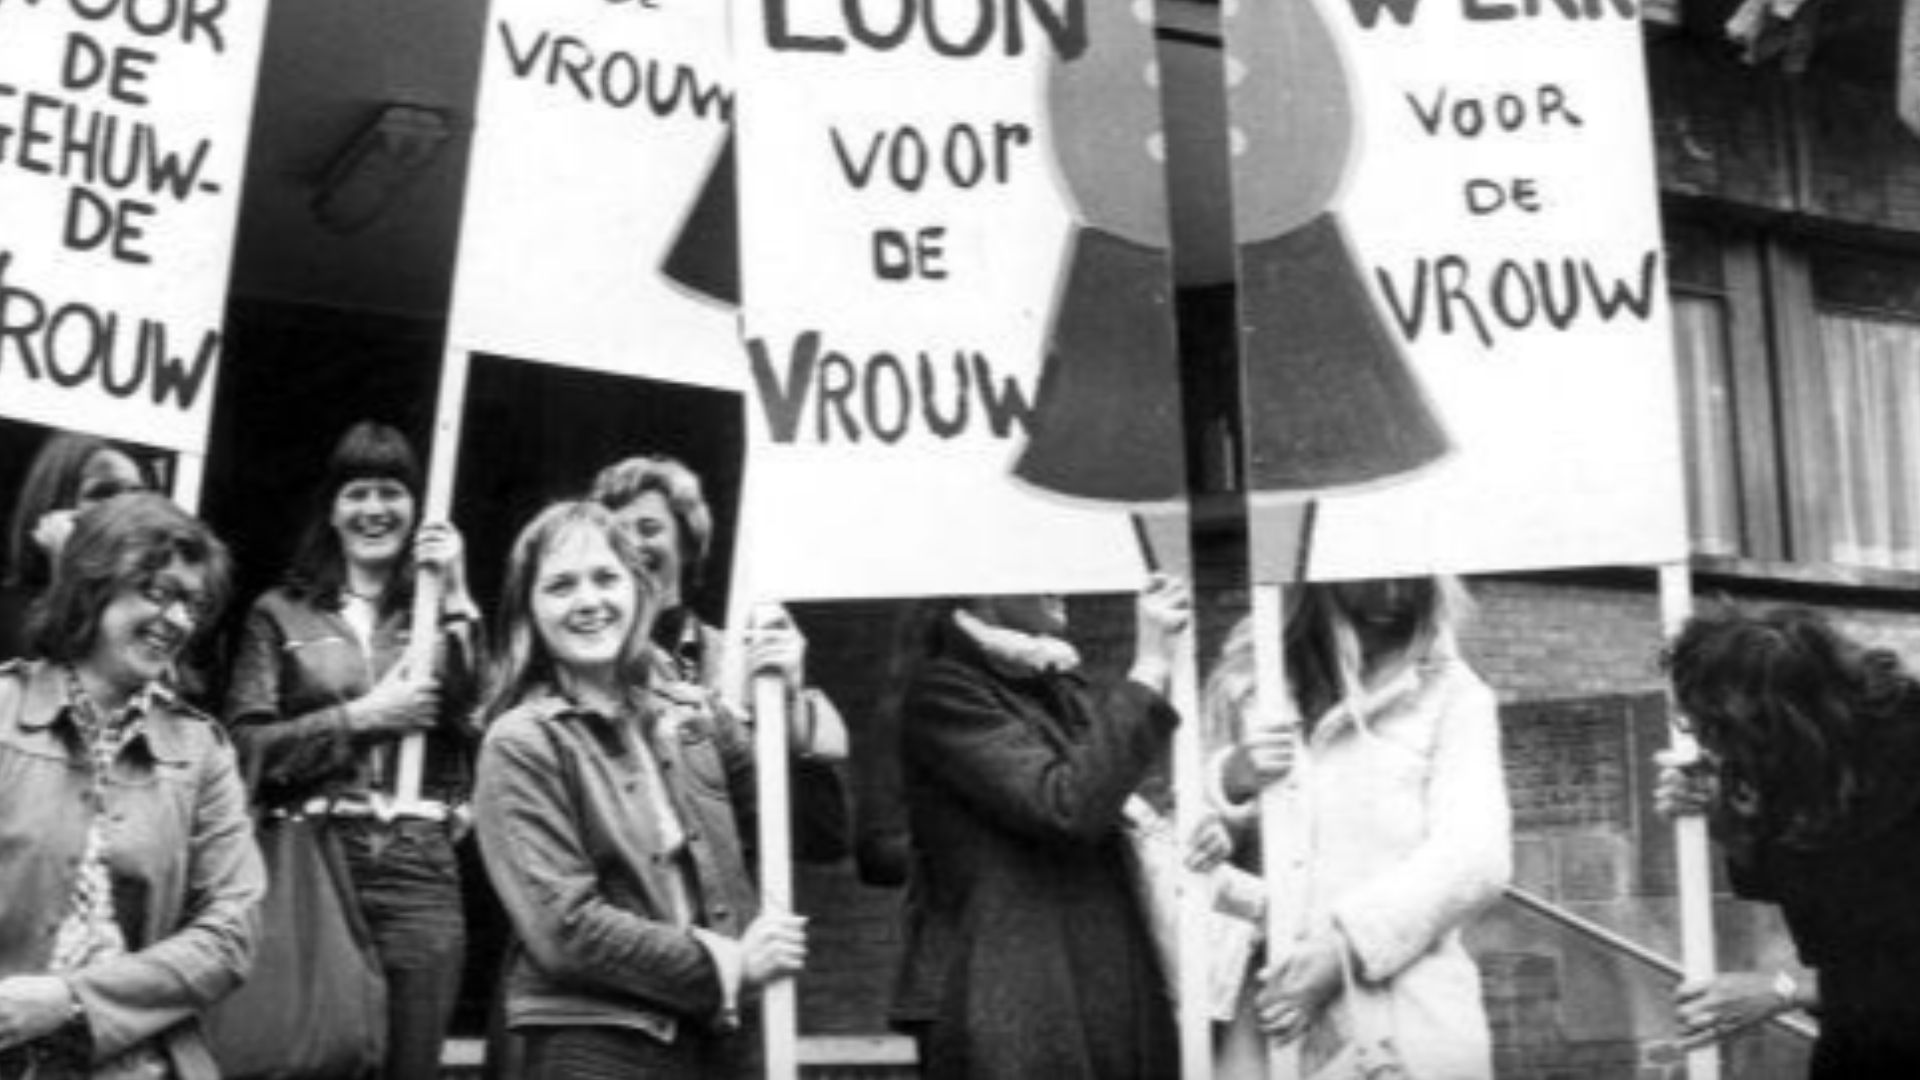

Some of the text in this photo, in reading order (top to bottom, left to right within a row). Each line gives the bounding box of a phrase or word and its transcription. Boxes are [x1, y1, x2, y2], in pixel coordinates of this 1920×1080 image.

[62, 31, 156, 105] DE
[498, 19, 734, 123] VROUW
[1403, 83, 1584, 138] VOOR
[63, 186, 156, 263] DE
[1464, 178, 1542, 215] DE
[872, 226, 949, 280] DE
[0, 250, 220, 410] ROUW
[1375, 250, 1657, 349] VROUW
[746, 329, 1061, 444] VROUW
